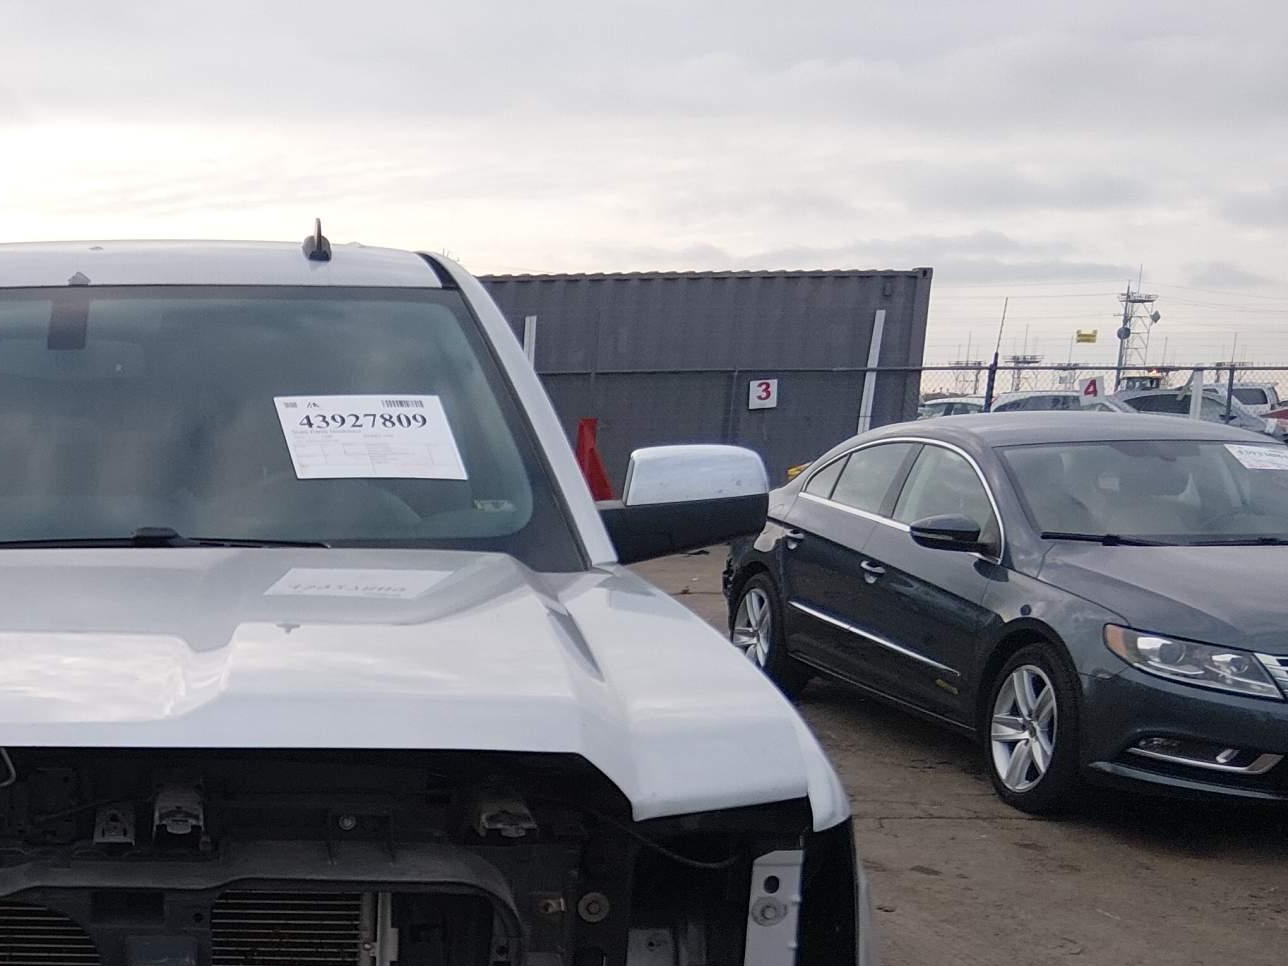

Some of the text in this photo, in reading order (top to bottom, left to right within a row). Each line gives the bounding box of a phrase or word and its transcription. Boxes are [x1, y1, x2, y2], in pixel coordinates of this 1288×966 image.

[756, 382, 771, 401] 3
[1084, 379, 1098, 397] 4
[299, 413, 427, 429] 43927809
